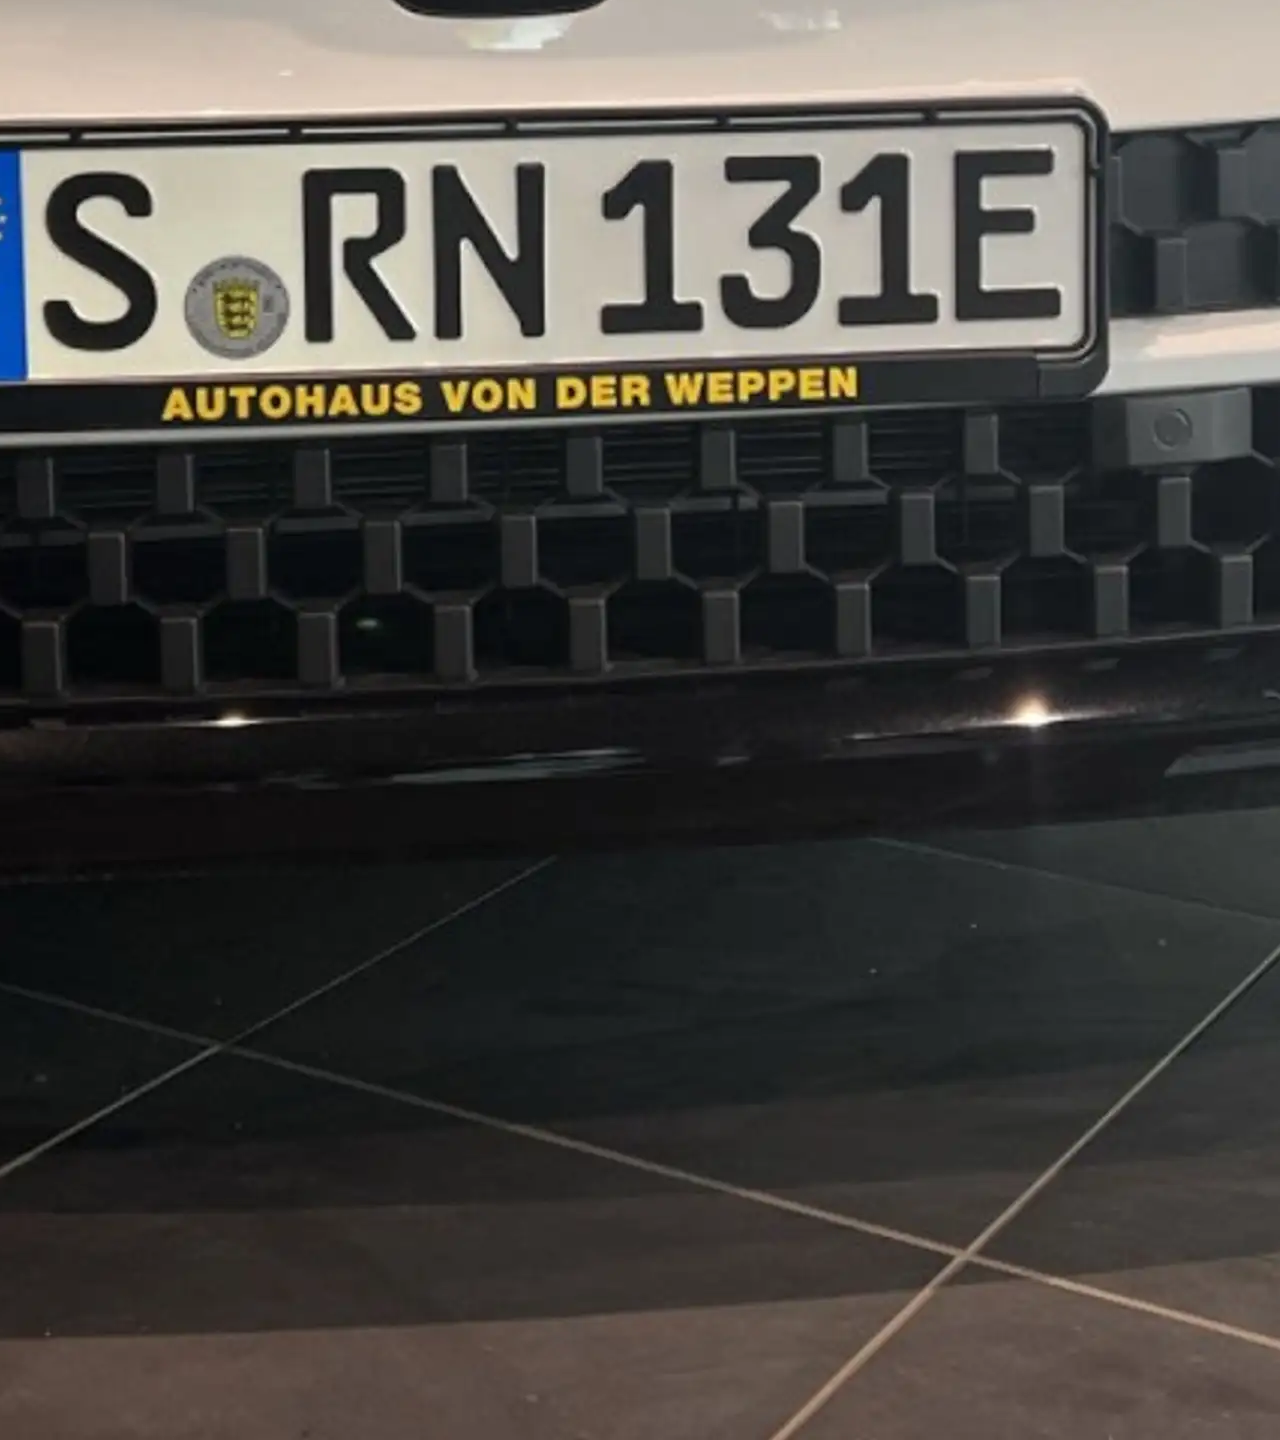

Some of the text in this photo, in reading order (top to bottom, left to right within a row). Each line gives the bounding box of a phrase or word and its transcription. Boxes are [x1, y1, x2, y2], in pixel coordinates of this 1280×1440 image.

[43, 146, 1061, 352] S RN 131E
[162, 366, 858, 421] AUTOHAUS VON DER WEPPEN
